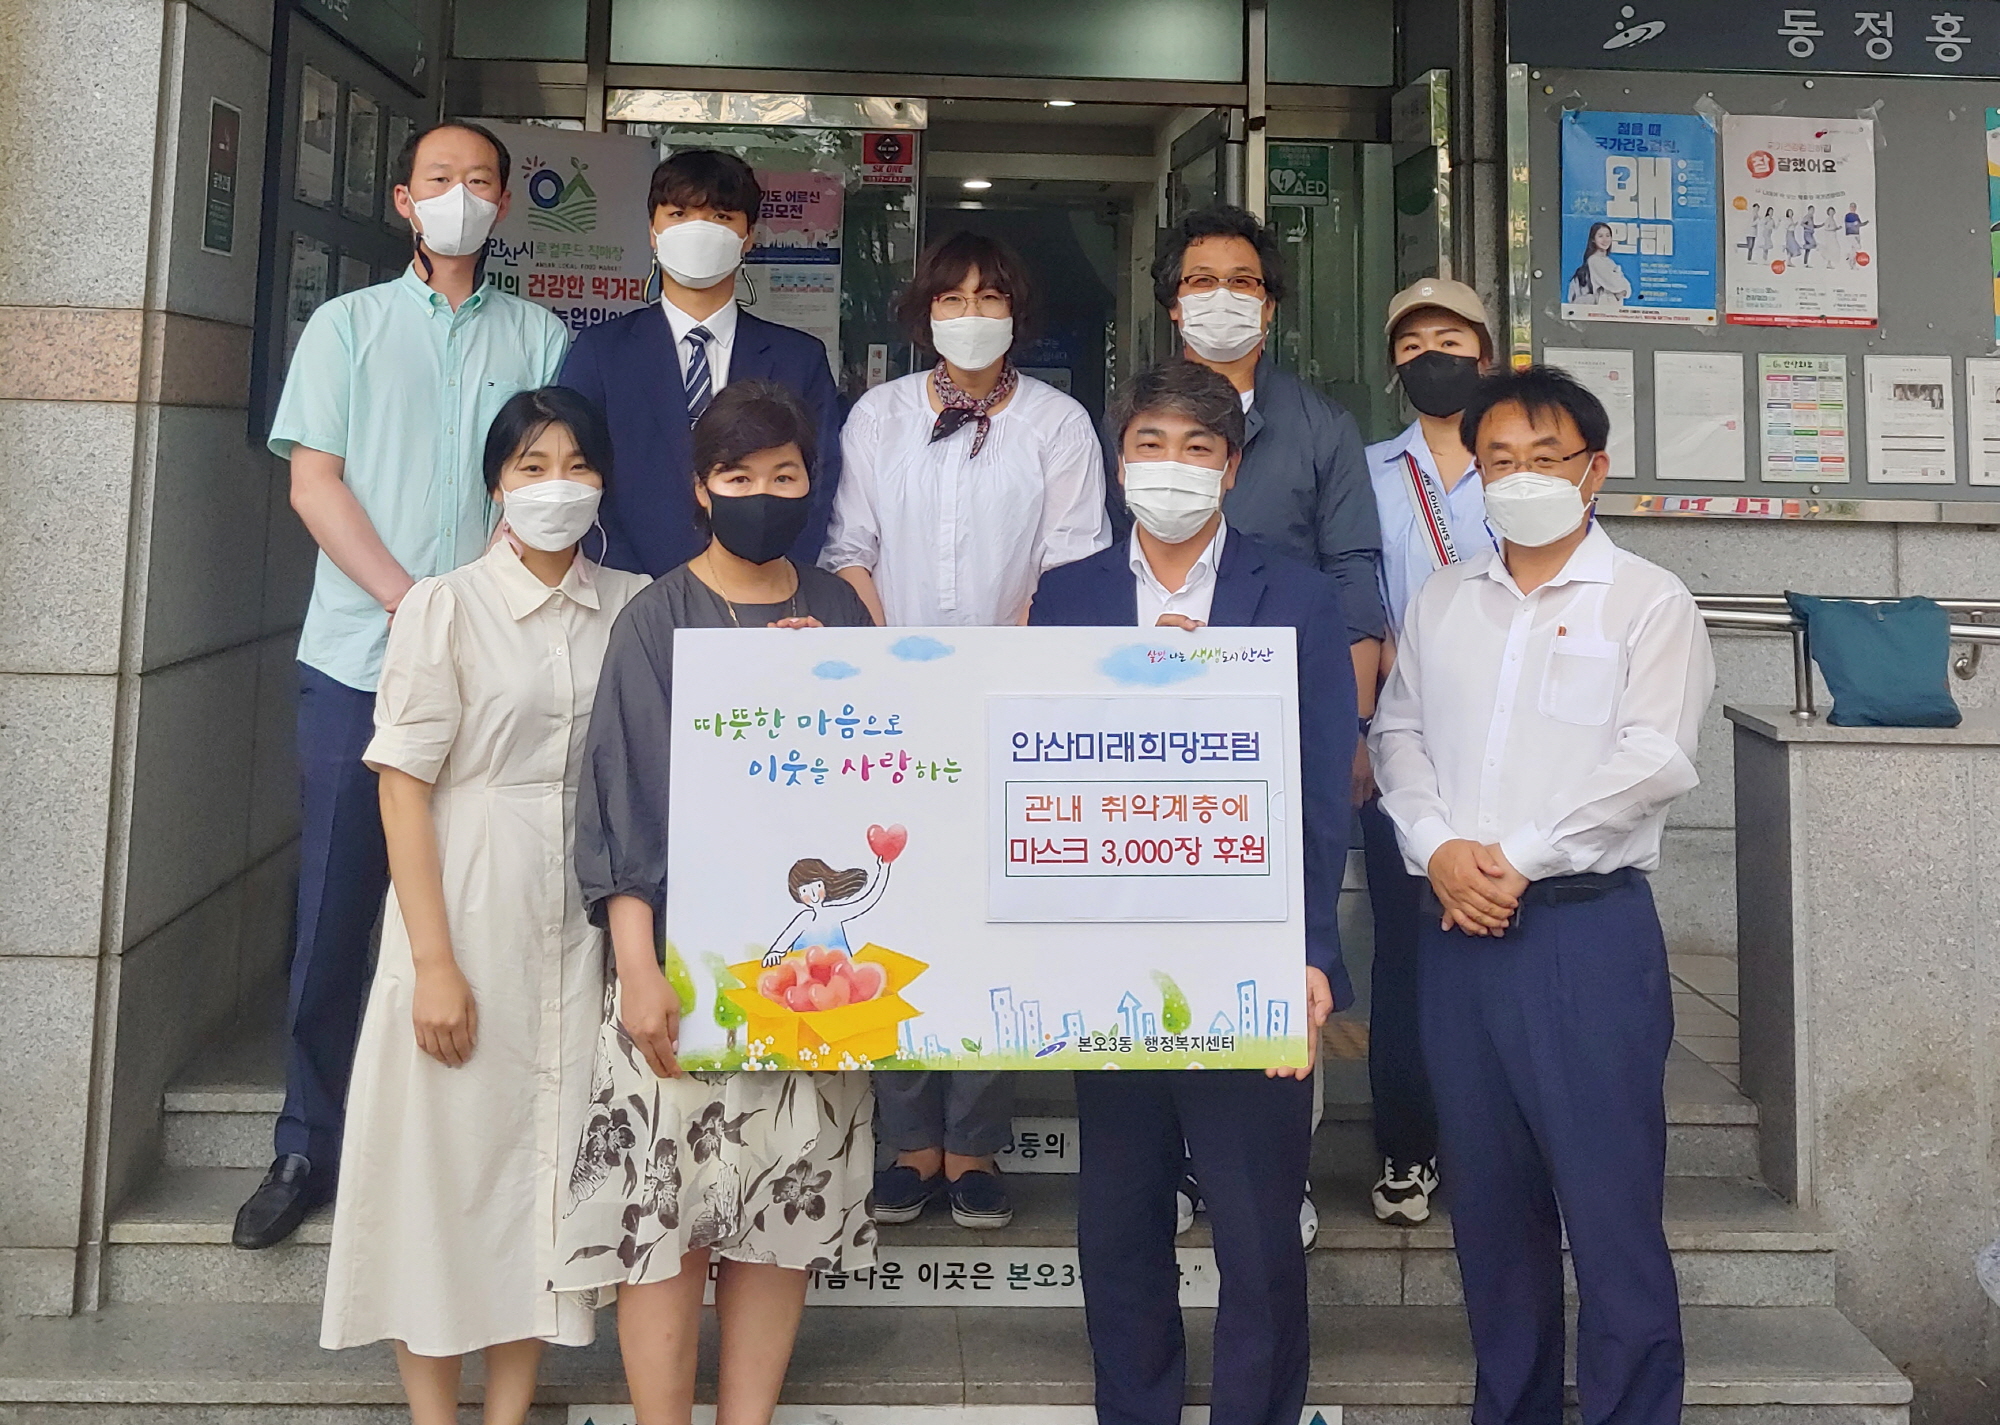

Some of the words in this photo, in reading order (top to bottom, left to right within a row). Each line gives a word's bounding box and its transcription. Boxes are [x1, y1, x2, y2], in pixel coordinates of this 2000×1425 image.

[1777, 157, 1837, 173] 잘했어요
[760, 190, 782, 202] 기도
[785, 190, 820, 203] 어르신
[1293, 180, 1327, 195] AED
[761, 203, 803, 219] 공모전
[489, 238, 534, 266] 안산시
[528, 274, 585, 299] 건강한
[592, 277, 645, 301] 먹거리
[1428, 490, 1451, 542] SNAPSHOT
[1446, 543, 1459, 564] THE
[1241, 647, 1274, 662] 안산
[694, 706, 786, 740] 따뜻한
[797, 703, 903, 739] 마음으로
[1012, 731, 1260, 764] 안산미래희망포럼
[749, 749, 829, 786] 이웃을
[842, 749, 962, 784] 사랑하는
[1025, 794, 1082, 822] 관내
[1101, 794, 1249, 824] 취약계층에
[1010, 837, 1089, 865] 마스크
[1101, 836, 1202, 867] 3,000장
[1213, 834, 1266, 864] 후원
[1077, 1036, 1133, 1053] 본오3동
[1144, 1035, 1235, 1053] 행정복지센터
[917, 1262, 994, 1291] 이곳은
[1006, 1262, 1082, 1291] 본오3
